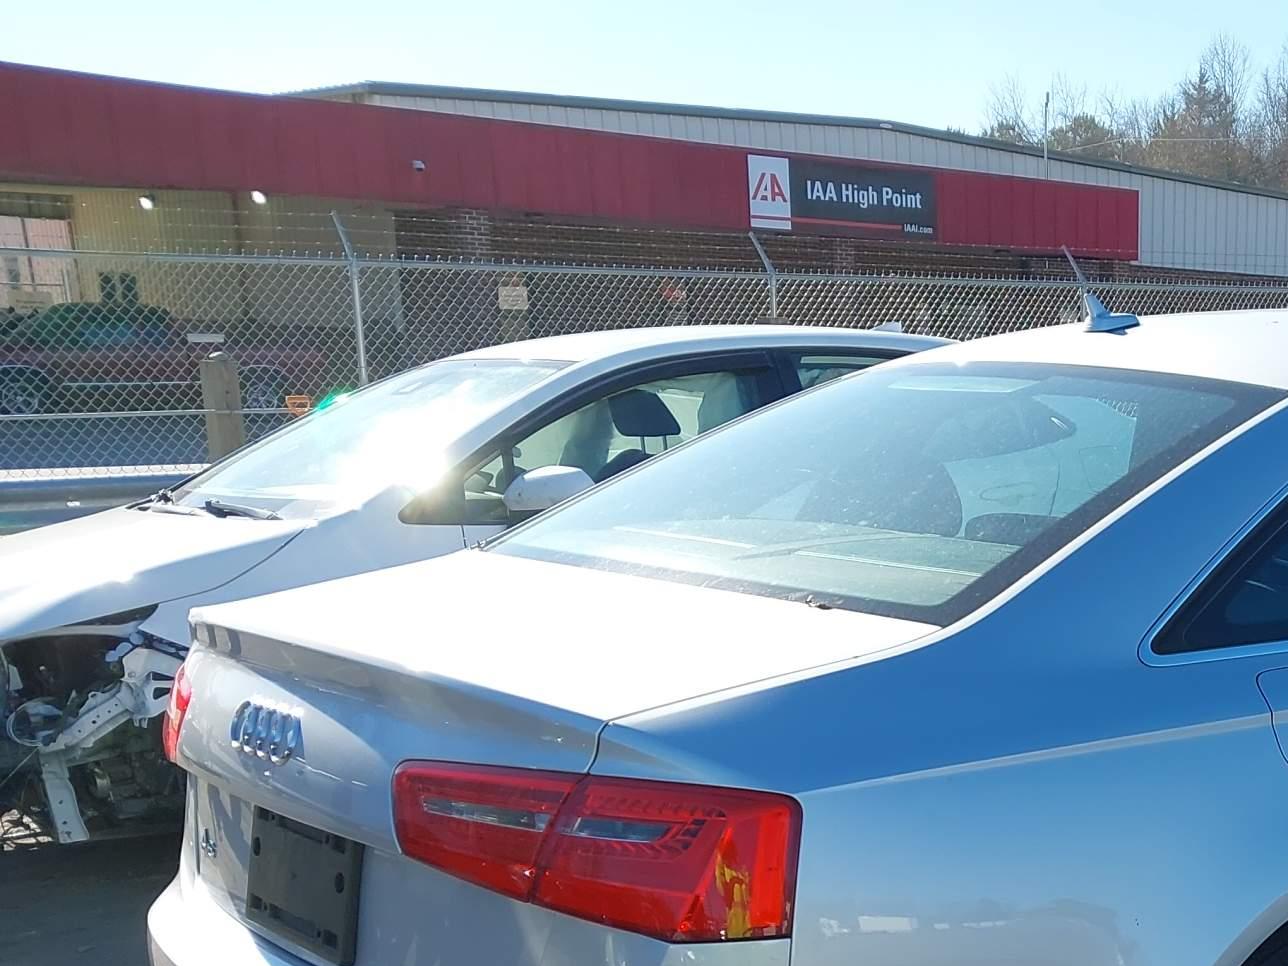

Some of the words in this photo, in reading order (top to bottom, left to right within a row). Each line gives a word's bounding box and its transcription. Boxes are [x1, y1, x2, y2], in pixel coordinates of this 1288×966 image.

[806, 179, 836, 201] IAA
[841, 183, 878, 209] High
[882, 187, 922, 209] Point
